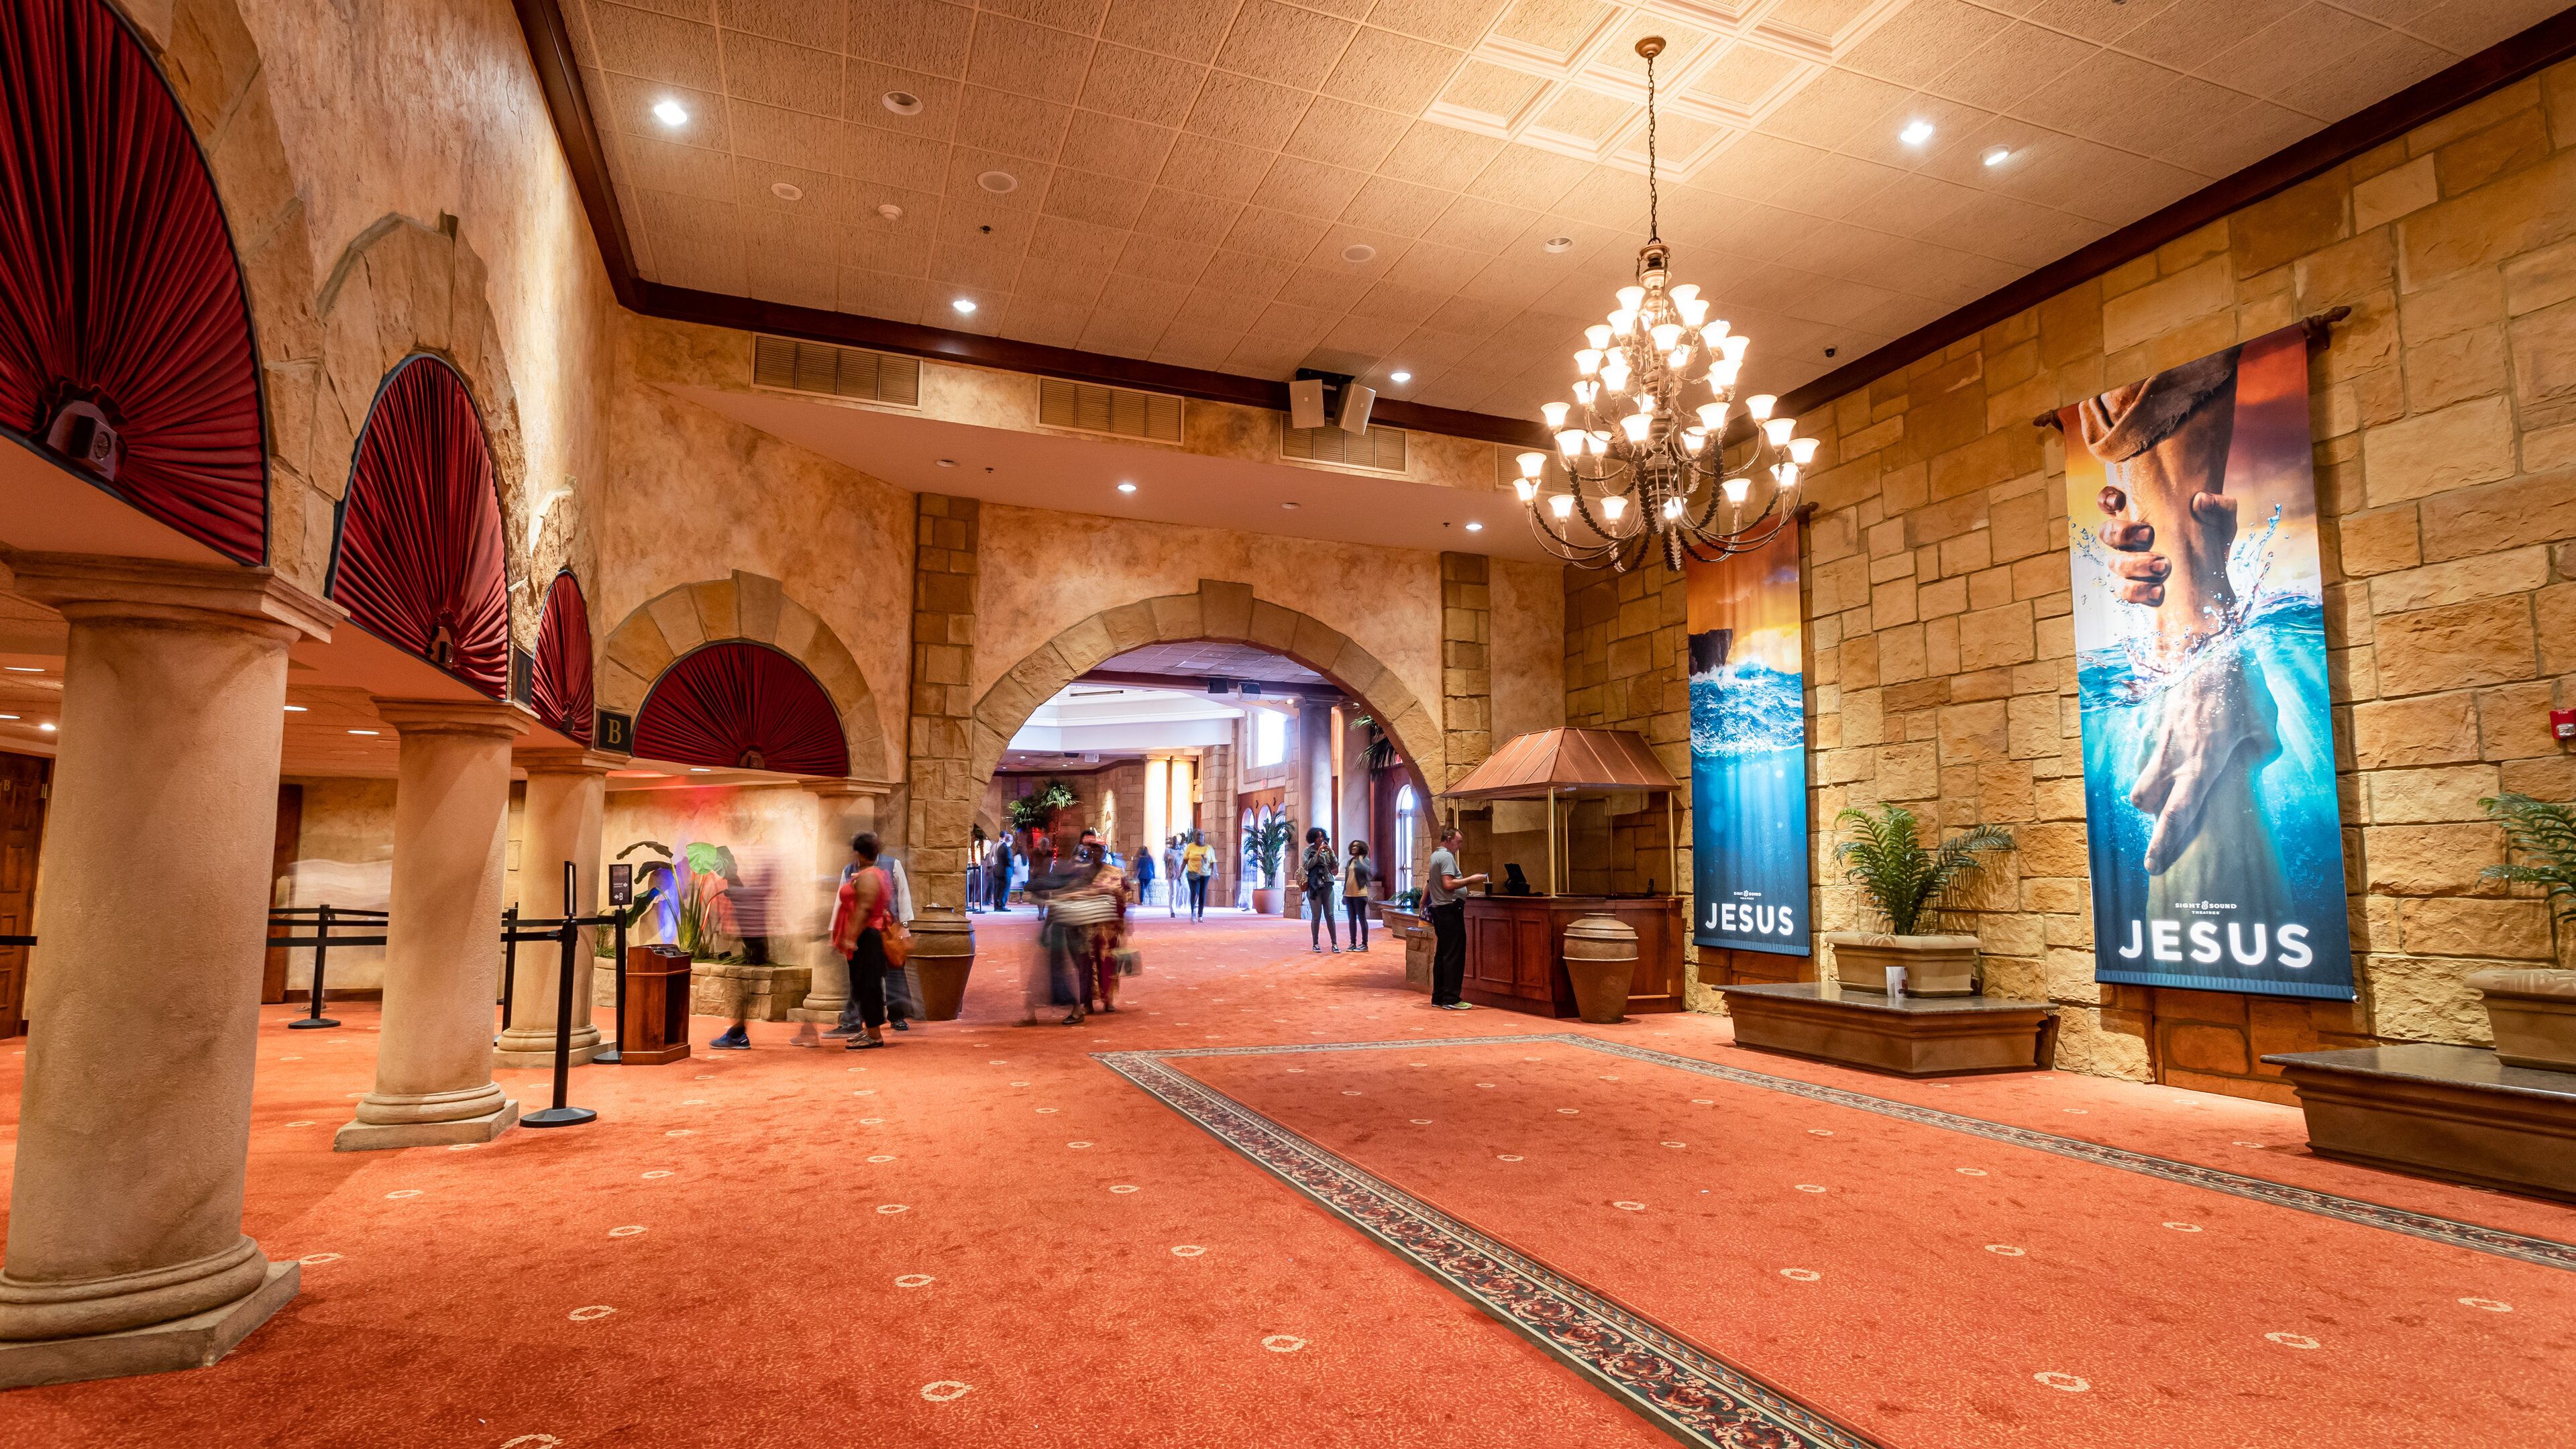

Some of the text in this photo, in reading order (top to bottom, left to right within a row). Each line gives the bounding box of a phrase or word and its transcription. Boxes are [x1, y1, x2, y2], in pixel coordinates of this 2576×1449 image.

[520, 660, 528, 693] A
[607, 718, 621, 744] B
[619, 892, 623, 900] B
[1705, 903, 1794, 936] JESUS
[2118, 920, 2313, 968] JESUS
